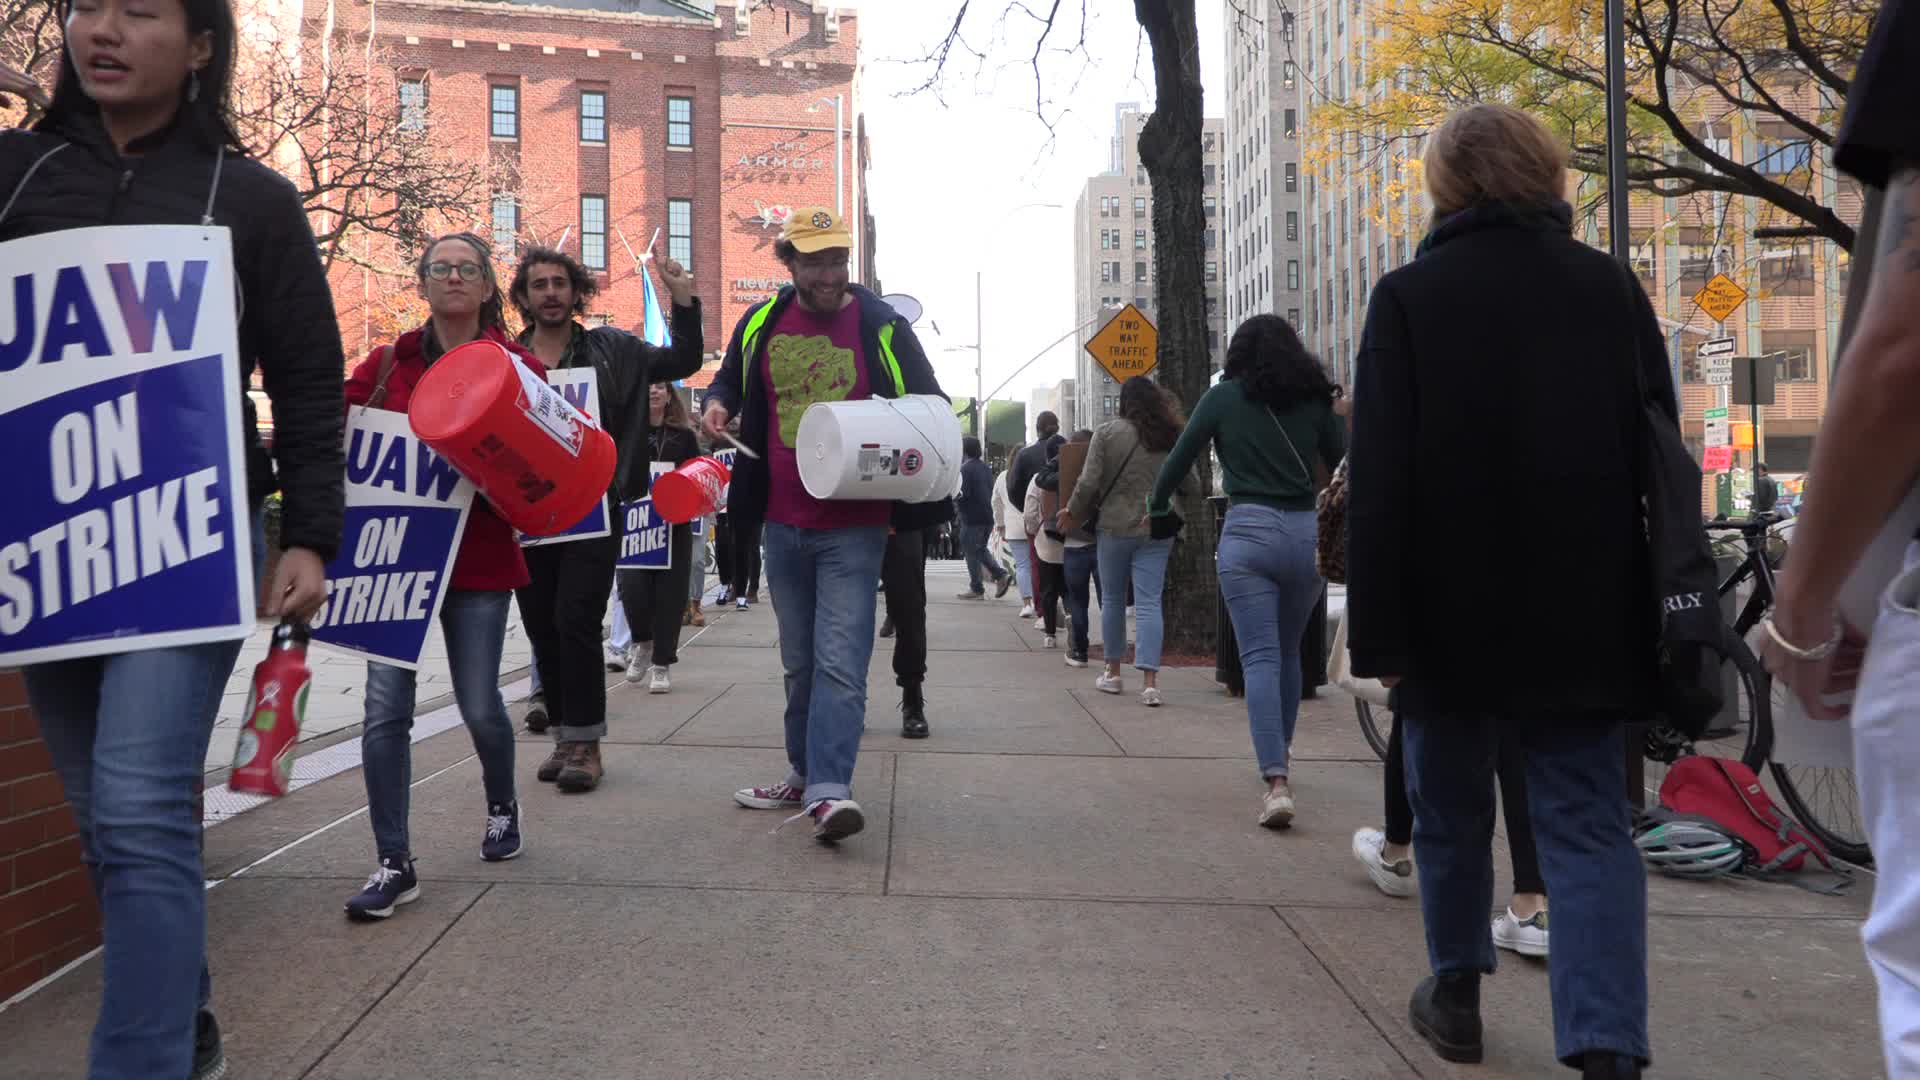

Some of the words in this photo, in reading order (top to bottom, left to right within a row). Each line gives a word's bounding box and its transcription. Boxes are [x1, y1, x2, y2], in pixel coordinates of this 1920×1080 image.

[1120, 320, 1139, 330] TWO
[1120, 334, 1138, 344] WAY
[1110, 347, 1148, 356] TRAFFIC
[1112, 360, 1144, 368] AHEAD
[49, 391, 142, 505] ON
[347, 428, 461, 502] UAW
[627, 504, 650, 532] ON
[0, 466, 224, 635] STRIKE
[353, 516, 409, 568] ON
[621, 524, 666, 559] TRIKE
